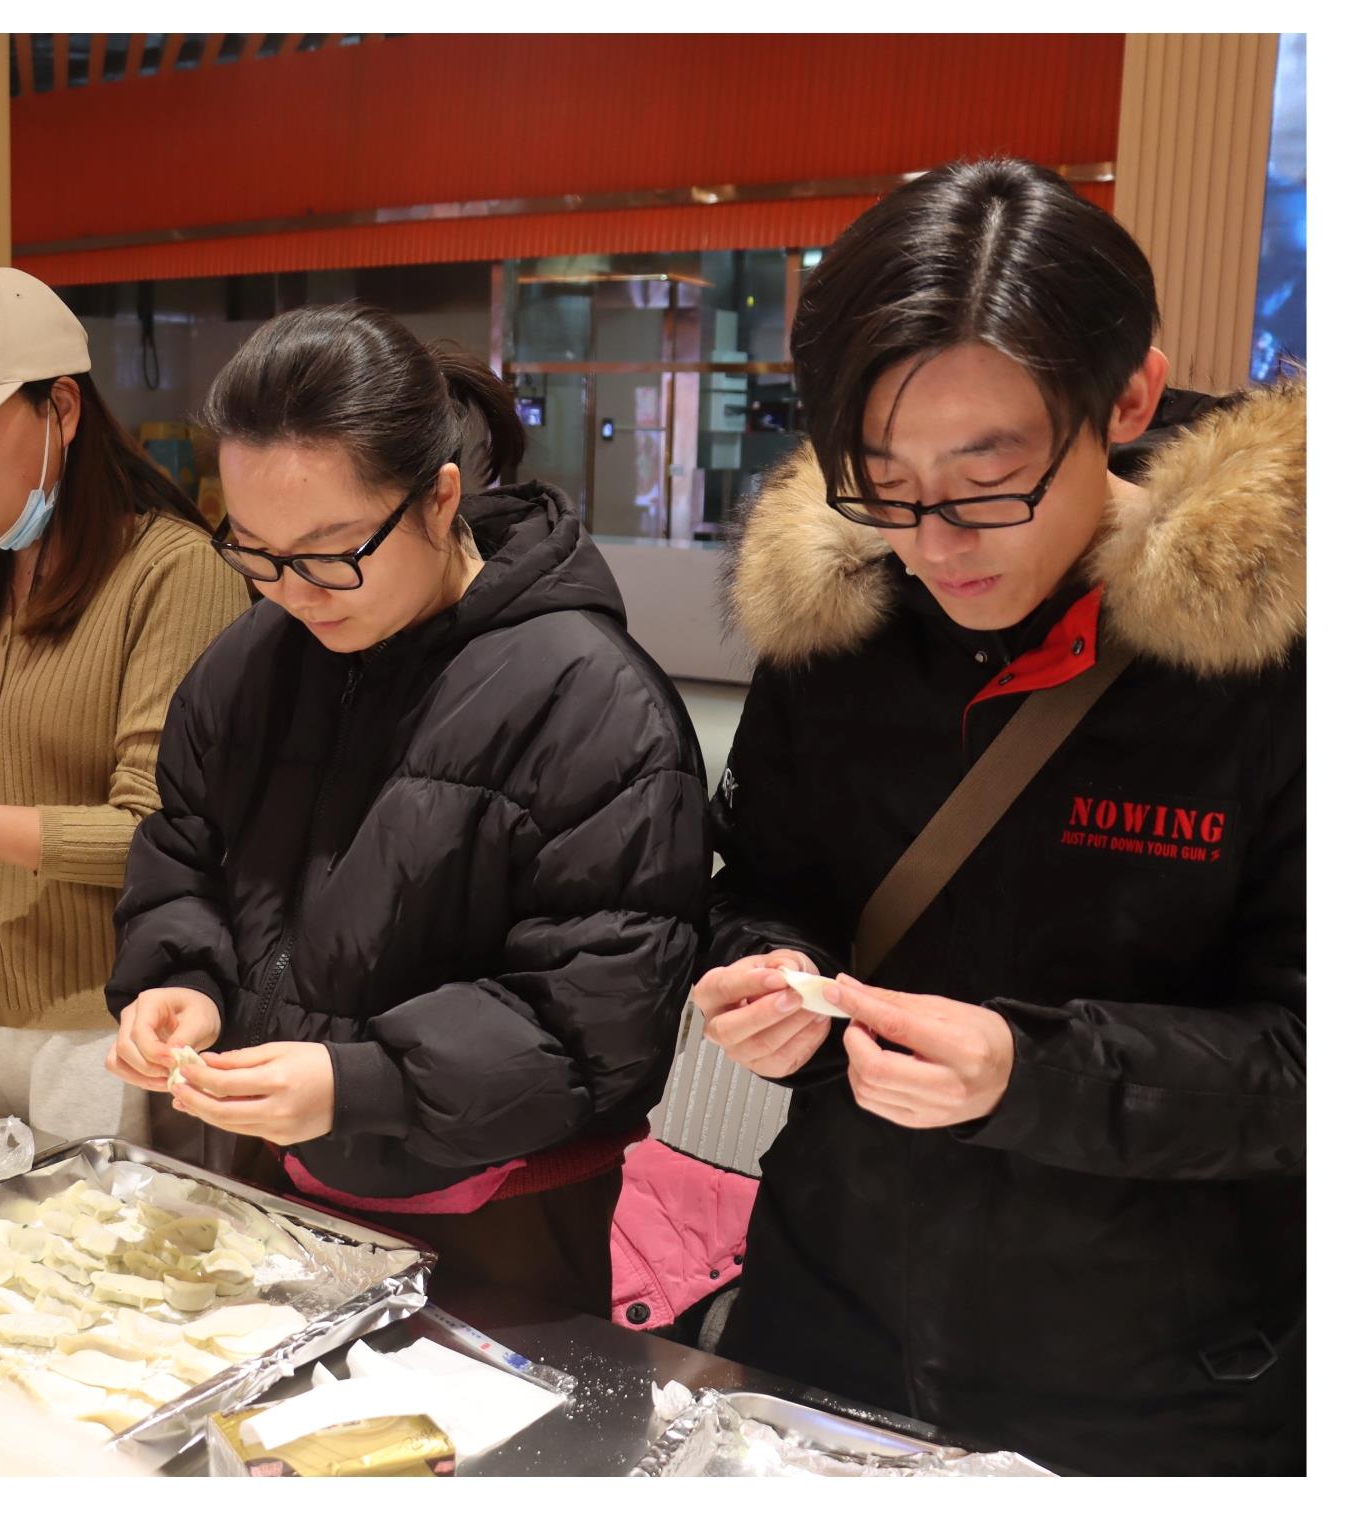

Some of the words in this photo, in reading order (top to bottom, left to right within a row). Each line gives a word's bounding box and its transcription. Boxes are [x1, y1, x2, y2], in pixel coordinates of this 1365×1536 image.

[1069, 796, 1226, 844] NOWING
[1060, 830, 1086, 847] JUST
[1087, 833, 1109, 850] PUT
[1111, 837, 1144, 855] DOWN
[1147, 841, 1178, 859] YOUR
[1181, 845, 1207, 862] GUN
